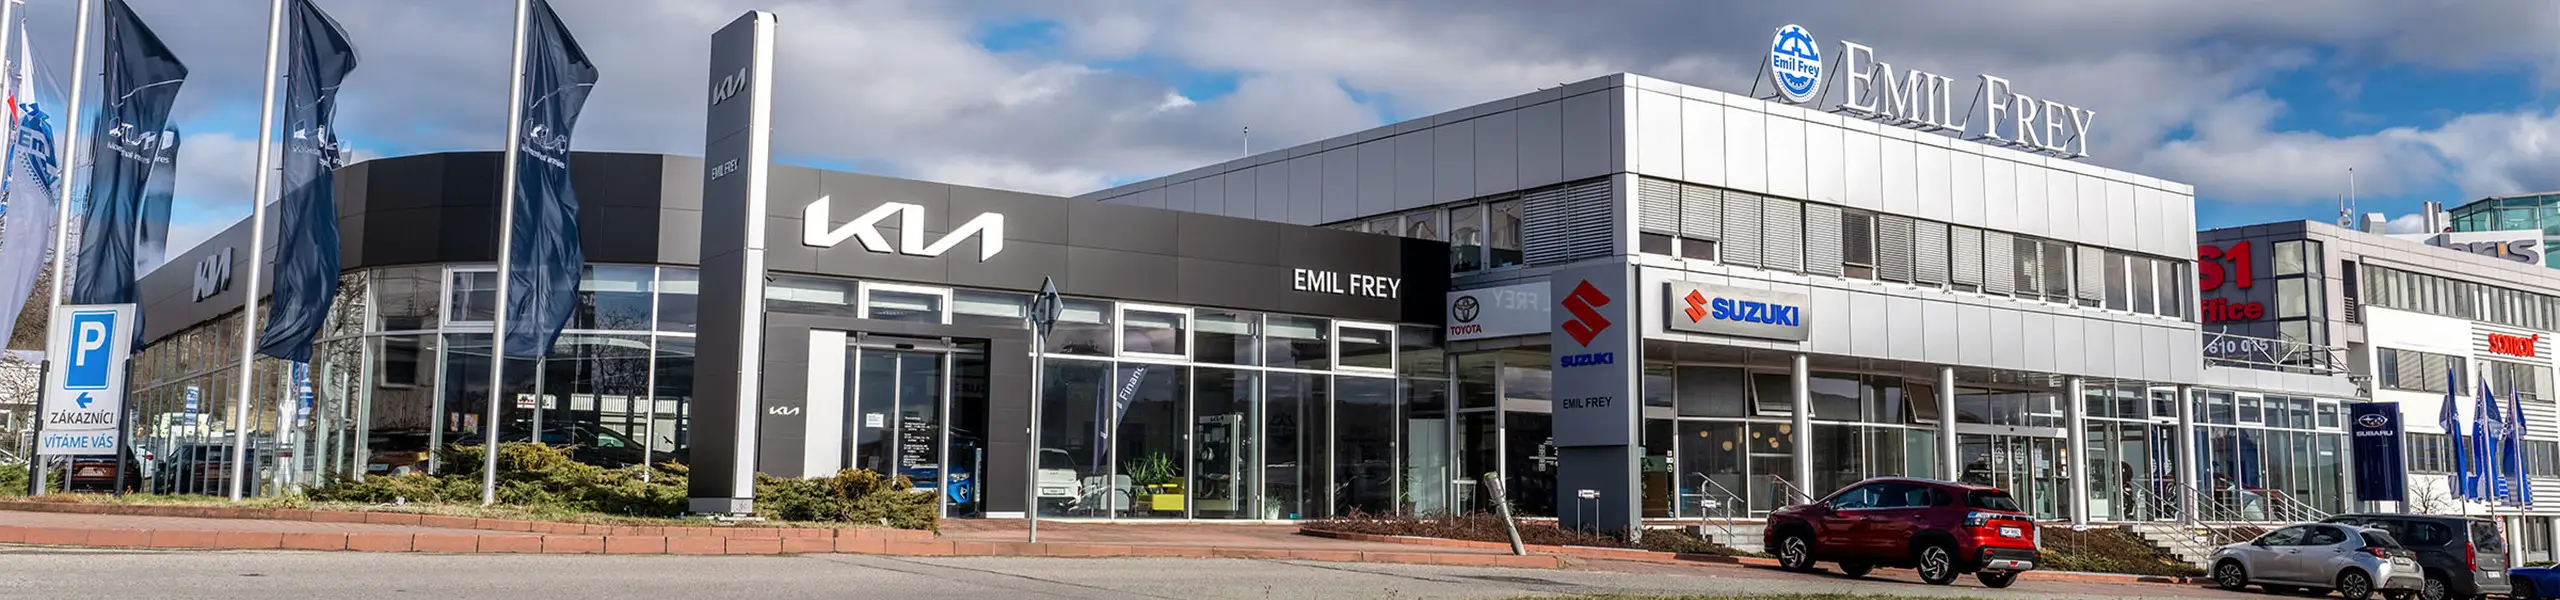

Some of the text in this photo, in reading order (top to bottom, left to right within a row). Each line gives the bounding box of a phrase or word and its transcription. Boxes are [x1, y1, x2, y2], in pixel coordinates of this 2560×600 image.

[1773, 55, 1820, 78] Emil Frey
[1840, 40, 2096, 157] EMIL FREY
[711, 158, 740, 180] EMIL FREY
[801, 194, 1004, 262] KIA
[2198, 240, 2252, 291] S1
[1293, 268, 1402, 299] EMIL FREY
[1712, 296, 1799, 327] SUZUKI
[2201, 298, 2264, 322] ffice
[1450, 324, 1482, 336] TOYOTA
[75, 321, 106, 366] P
[1561, 351, 1613, 368] SUZUKI
[1563, 396, 1613, 410] EMIL FREY
[50, 409, 114, 425] ZÁKAZNÍCI
[44, 433, 113, 448] VÍTÁME VÁS
